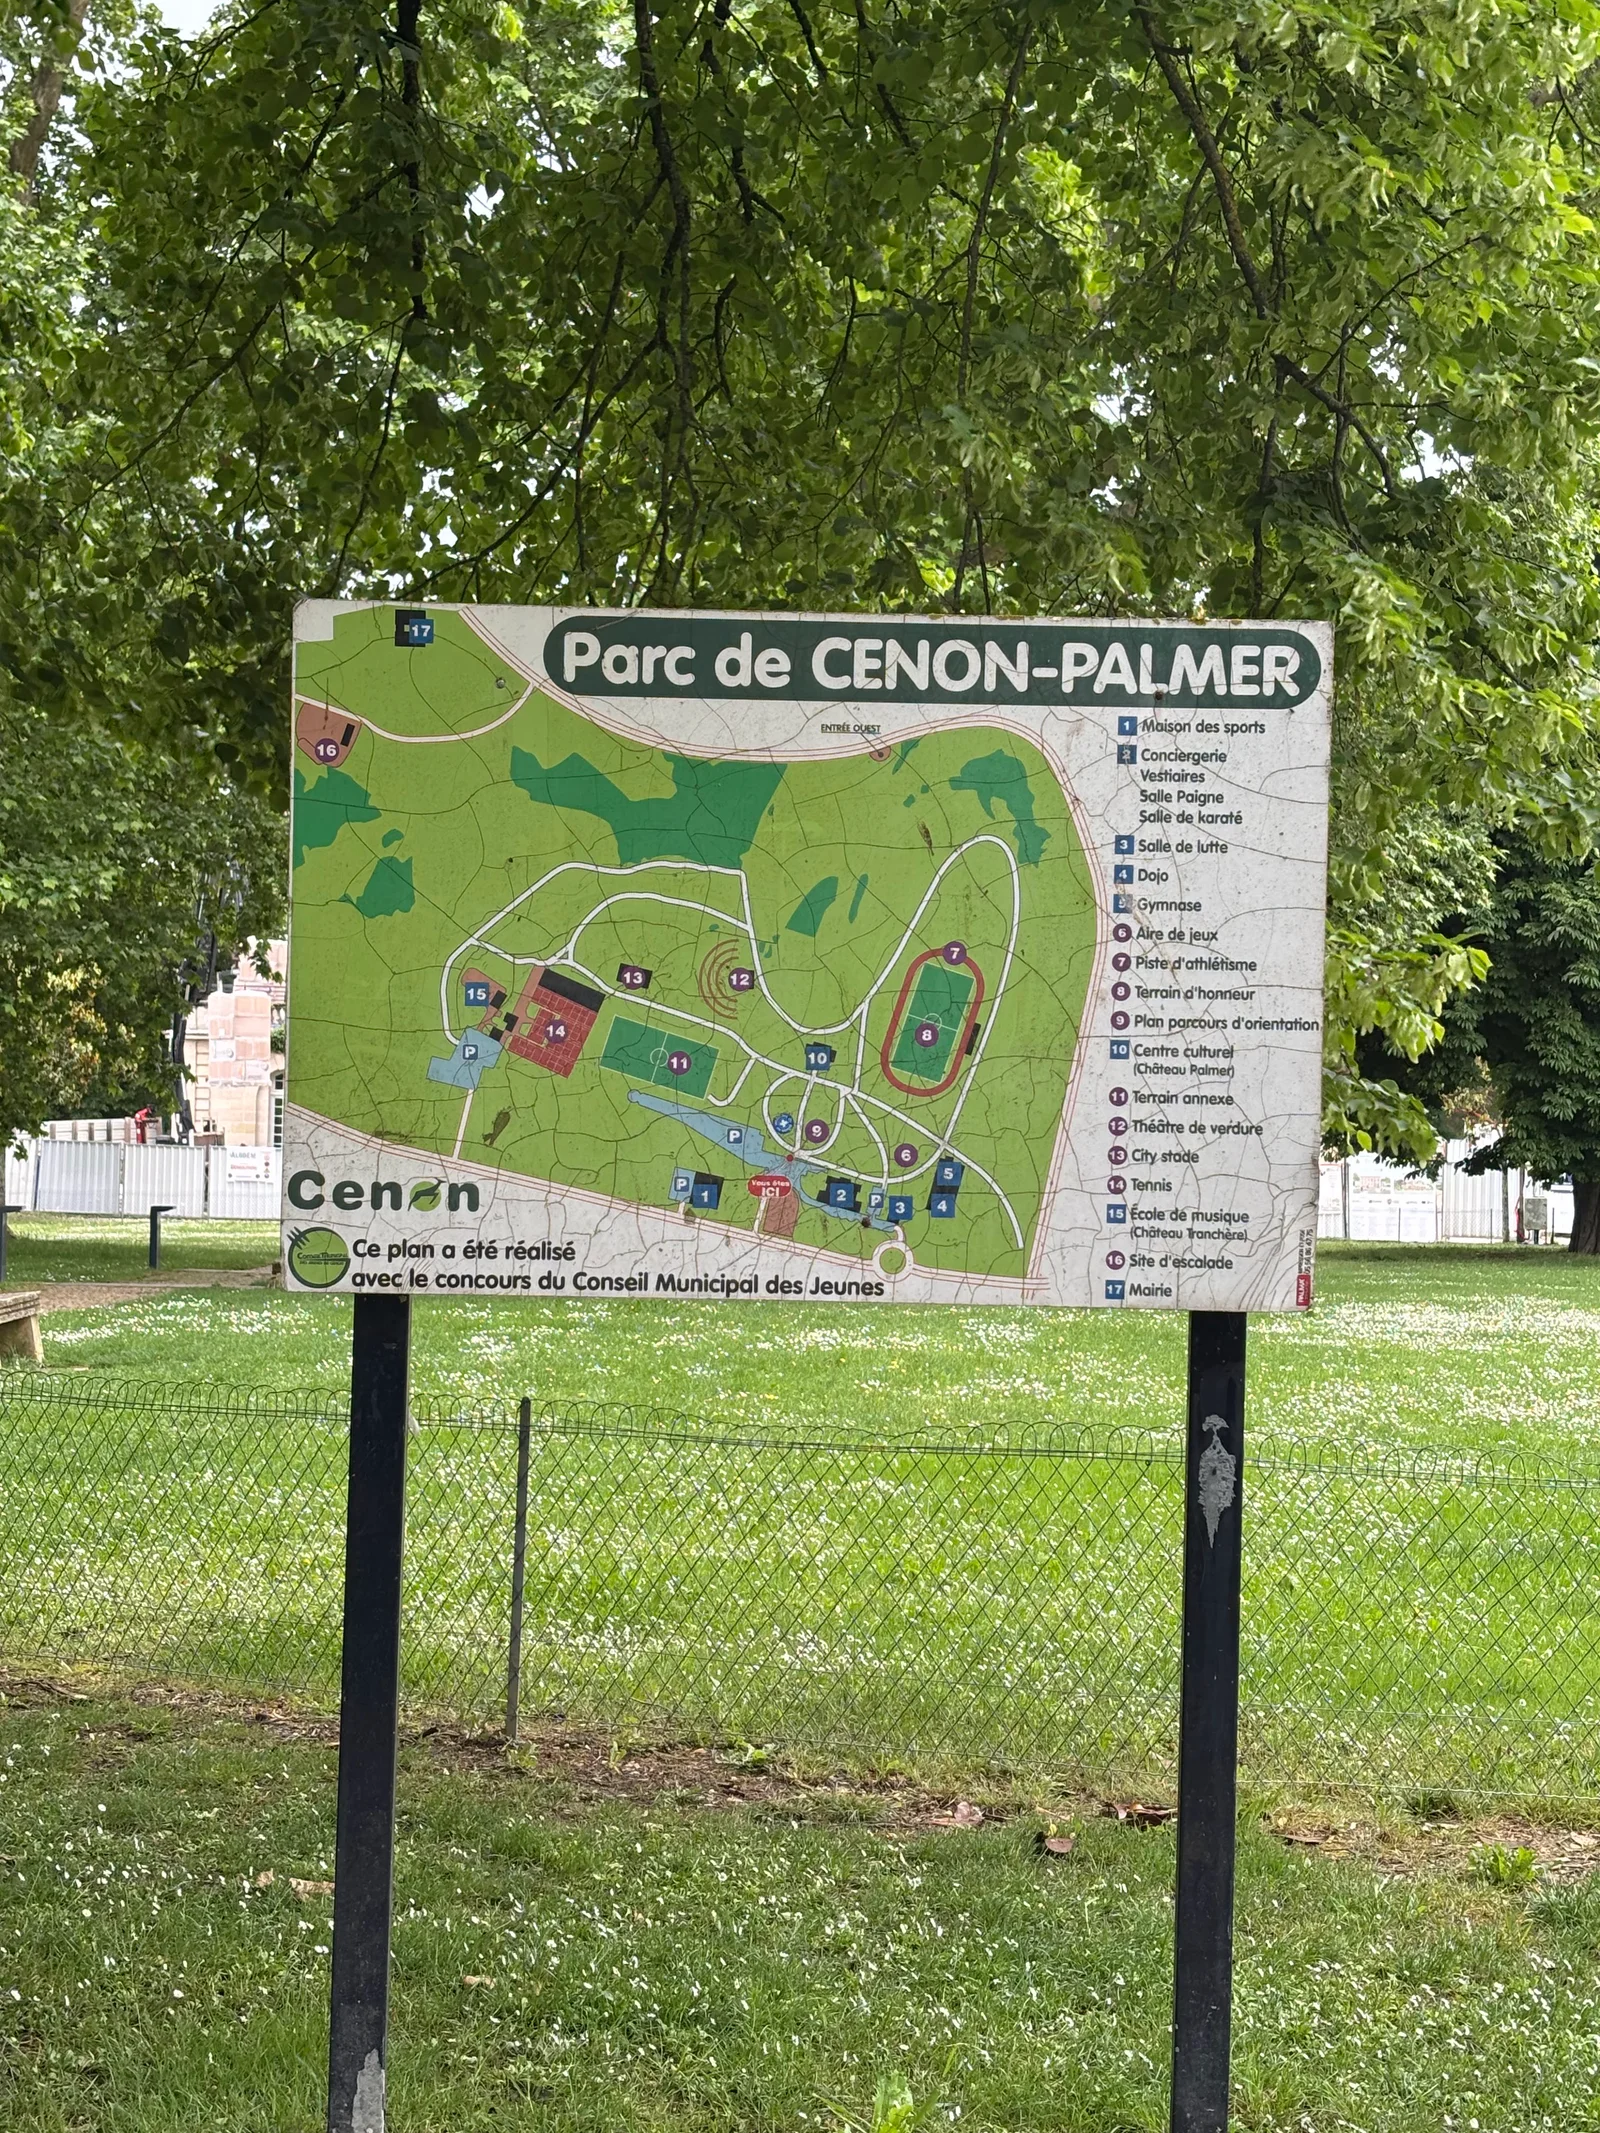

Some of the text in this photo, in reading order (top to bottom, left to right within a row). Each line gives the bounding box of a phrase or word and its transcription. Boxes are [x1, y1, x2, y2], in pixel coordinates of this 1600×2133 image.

[411, 625, 431, 637] 17
[563, 631, 1300, 696] Parc de CENON-PALMER
[821, 722, 881, 733] ENTRÉE OUEST
[1141, 719, 1191, 733] Maison
[1195, 720, 1219, 733] des
[1224, 721, 1265, 737] sports
[317, 744, 337, 756] 16
[1141, 749, 1227, 765] Conciergerie
[1140, 769, 1205, 783] Vestiaires
[1139, 790, 1224, 807] Salle Paigne
[1139, 810, 1243, 825] Salle de karaté
[1138, 840, 1171, 854] Salle
[1176, 840, 1193, 854] de
[1197, 840, 1229, 854] lutte
[1138, 869, 1169, 885] Dojo
[1137, 898, 1202, 914] Gymnase
[1136, 927, 1164, 941] Aire
[1168, 928, 1186, 941] de
[1189, 928, 1218, 945] jeux
[951, 946, 960, 959] 7
[1135, 956, 1169, 970] Piste
[1173, 956, 1258, 972] d'athlétisme
[623, 972, 643, 984] 13
[730, 974, 750, 985] 12
[467, 988, 486, 1000] 15
[1135, 985, 1180, 999] Terrain
[1184, 986, 1256, 1000] d'honneur
[546, 1025, 566, 1038] 14
[1134, 1015, 1164, 1029] Plan
[1168, 1017, 1228, 1034] parcours
[1232, 1016, 1320, 1032] d'orientation
[922, 1029, 932, 1041] 8
[465, 1046, 476, 1058] P
[1112, 1044, 1234, 1058] 10 Centre culturel
[670, 1057, 689, 1069] 11
[808, 1052, 827, 1065] 10
[1133, 1063, 1235, 1079] (Château Palmer)
[1111, 1091, 1234, 1106] 11 Terrain annexe
[812, 1125, 822, 1138] 9
[1109, 1119, 1264, 1136] 12 Théâtre de verdure
[729, 1129, 741, 1143] P
[901, 1149, 911, 1162] 6
[1109, 1150, 1200, 1165] 13 City stade
[943, 1168, 954, 1180] 5
[676, 1179, 688, 1191] P
[761, 1187, 780, 1197] ICI
[1108, 1179, 1172, 1192] 14 Tennis
[836, 1189, 847, 1202] 2
[871, 1195, 882, 1207] P
[895, 1202, 906, 1214] 3
[936, 1200, 947, 1212] 4
[1108, 1203, 1250, 1225] 15 École de musique
[1130, 1226, 1248, 1242] (Château Tranchère)
[352, 1238, 576, 1263] Ce plan a été réalisé
[1107, 1254, 1234, 1270] 16 Site d'escalade
[351, 1269, 885, 1298] avec le concours du Conseil Municipal des Jeunes
[1106, 1283, 1172, 1298] 17 Mairie
